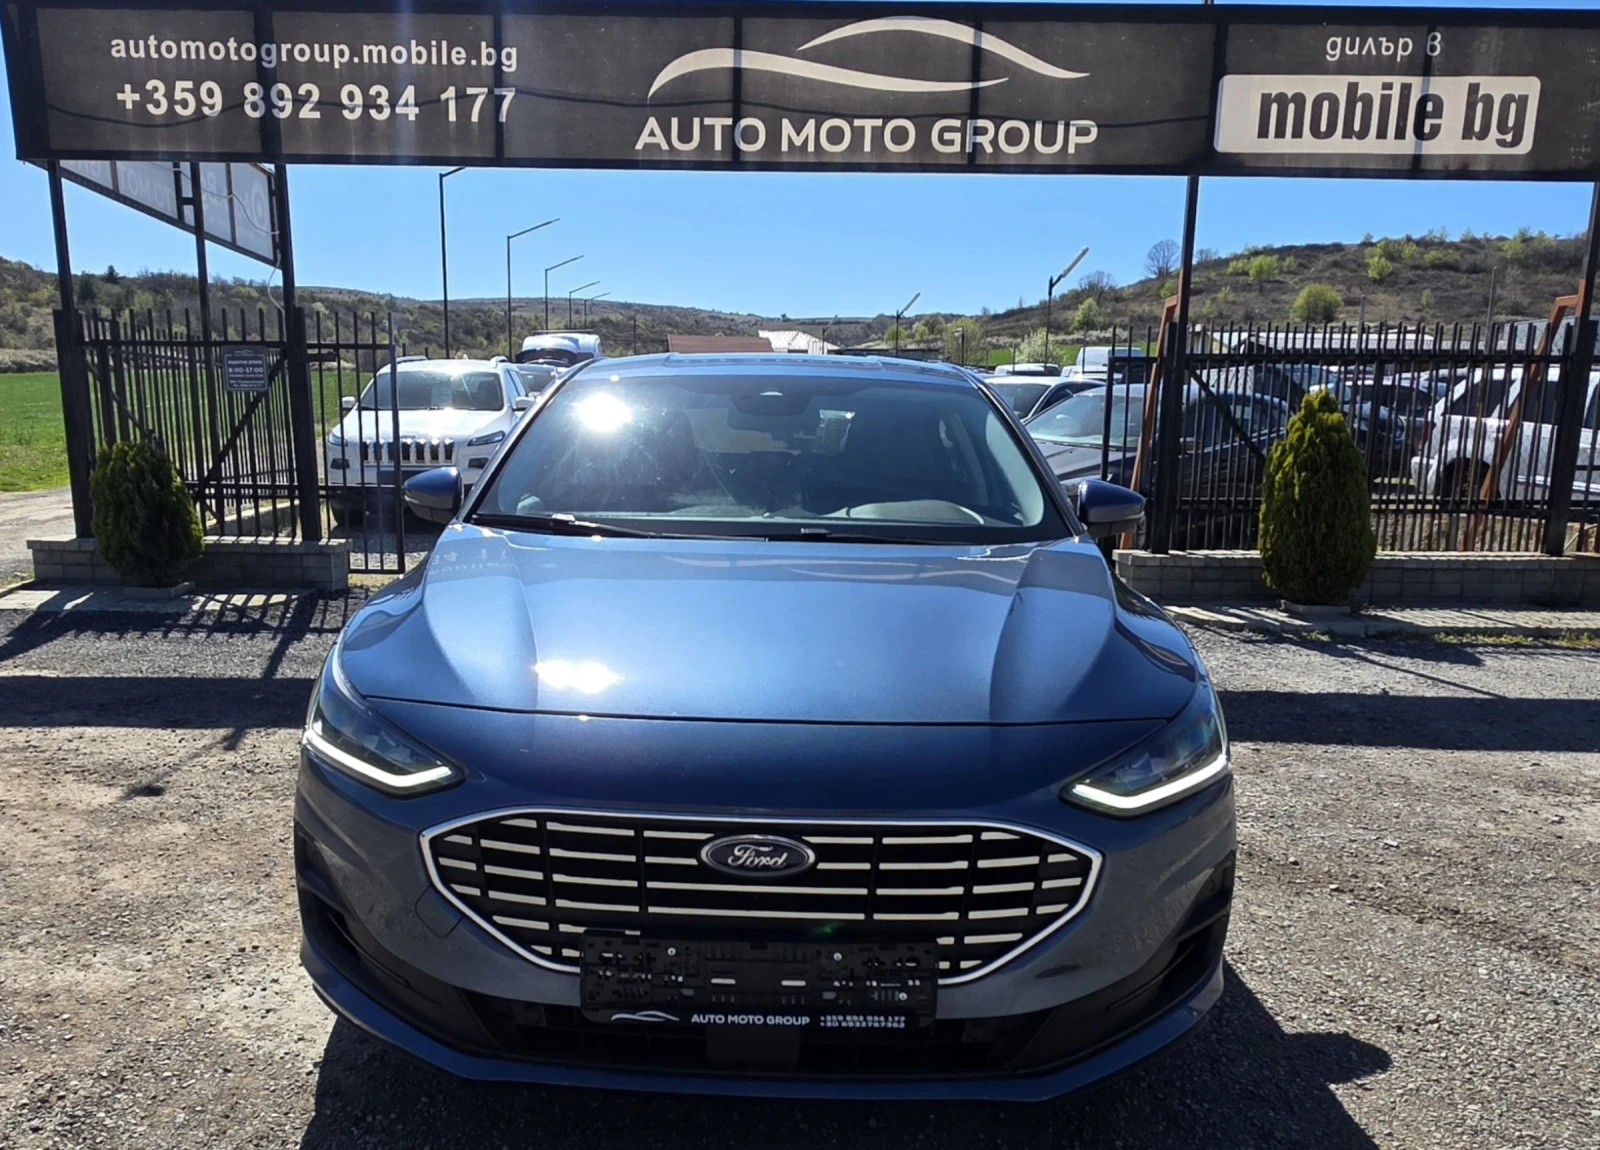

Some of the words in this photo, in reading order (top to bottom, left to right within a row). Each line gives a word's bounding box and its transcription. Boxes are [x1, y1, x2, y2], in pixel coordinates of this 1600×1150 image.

[110, 34, 518, 73] automotogroup.mobile.bg
[116, 79, 223, 117] +359
[243, 82, 321, 119] 892
[340, 83, 419, 121] 934
[440, 85, 517, 123] 177
[1256, 80, 1445, 142] mobile
[1461, 82, 1530, 149] bg
[634, 116, 766, 152] AUTO
[781, 118, 916, 154] MOTO
[931, 118, 1098, 155] GROUP
[727, 844, 789, 868] Ford
[691, 1013, 726, 1024] AUTO
[727, 1014, 765, 1025] MOTO
[766, 1015, 811, 1026] GROUP
